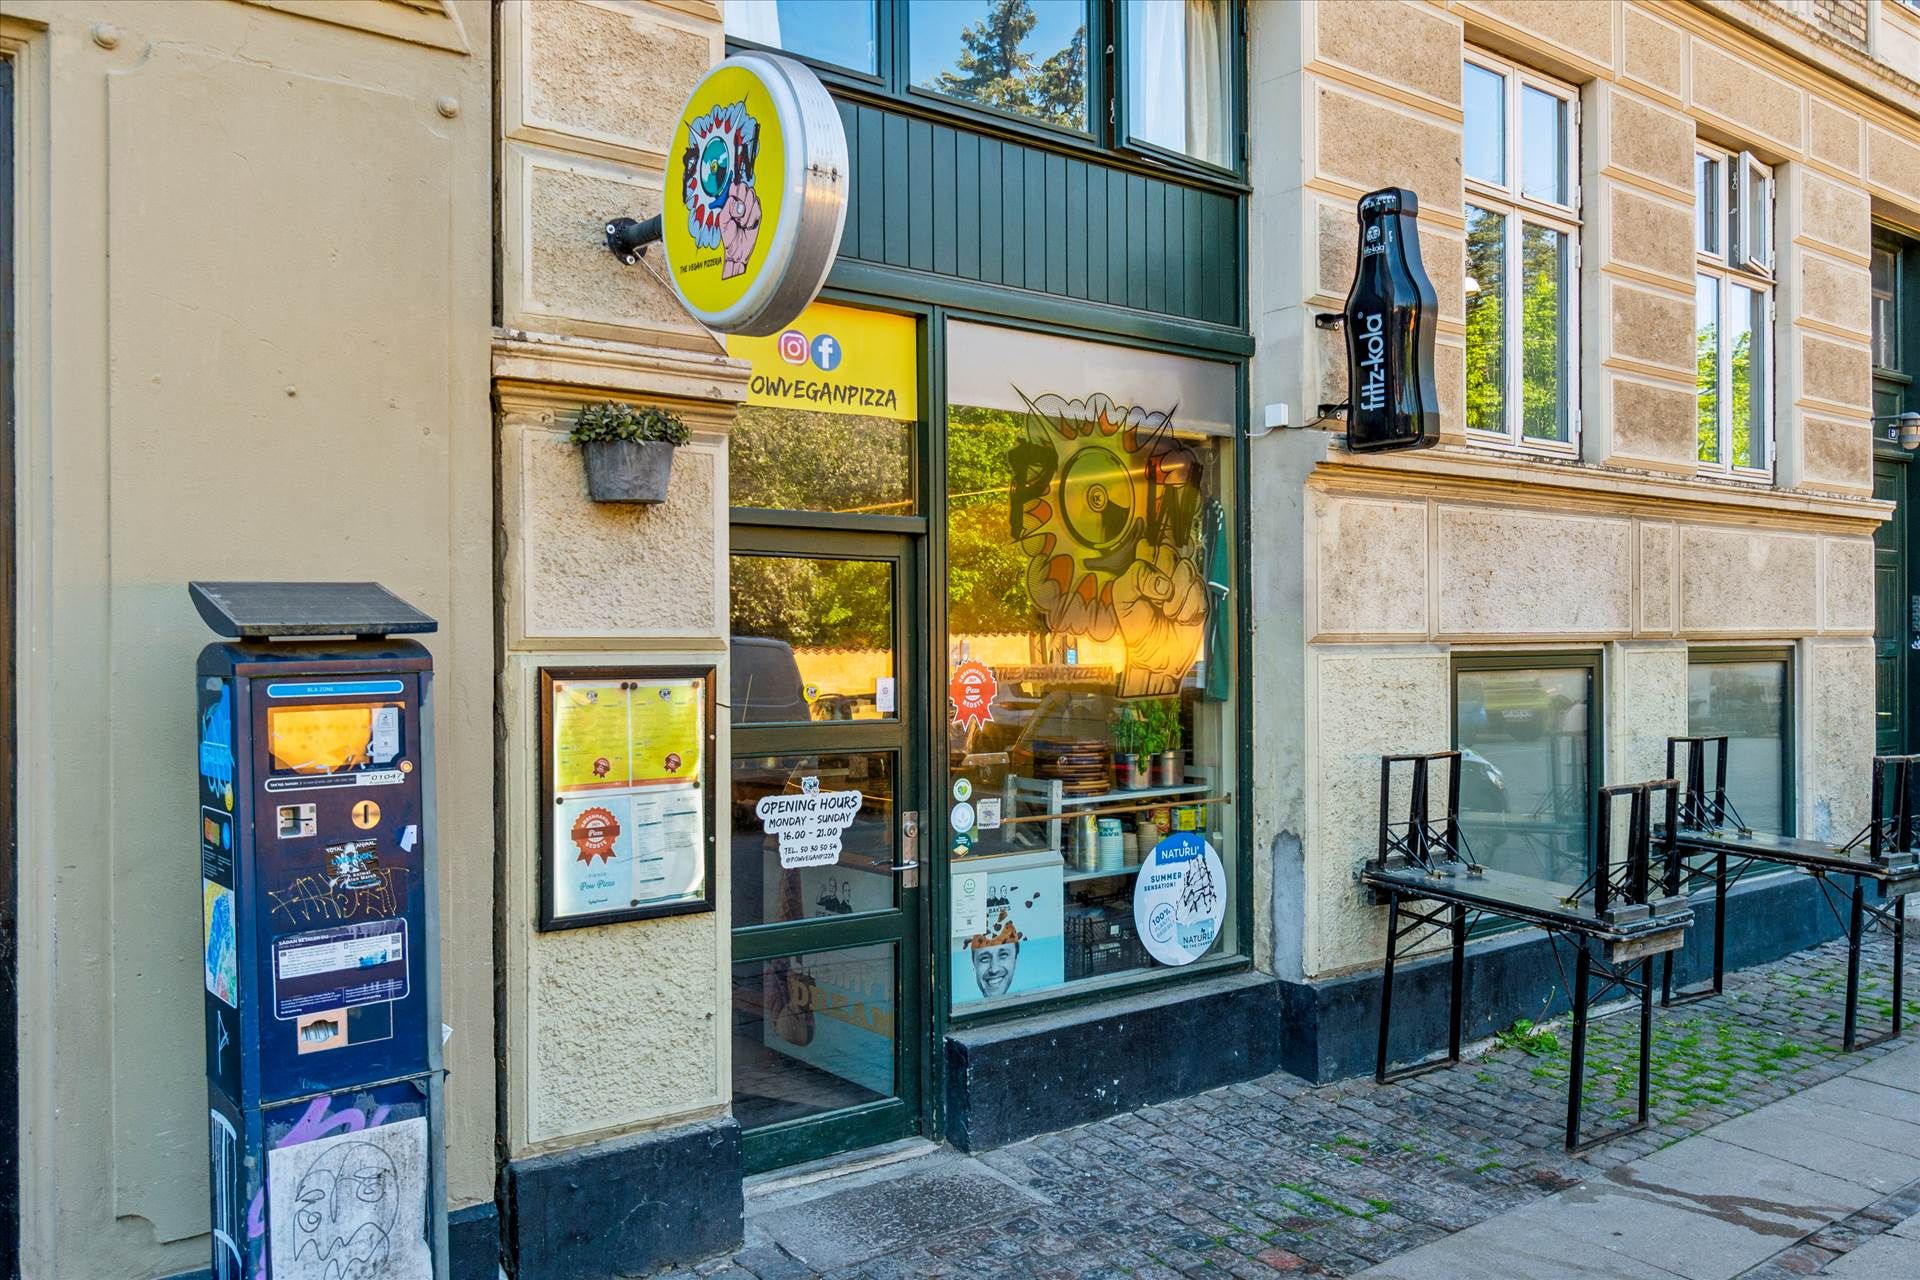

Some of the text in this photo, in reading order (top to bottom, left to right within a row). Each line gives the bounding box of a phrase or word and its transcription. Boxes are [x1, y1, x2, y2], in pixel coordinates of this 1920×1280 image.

[1360, 313, 1385, 412] fritz-kola
[761, 795, 858, 815] OPENING HOURS
[768, 816, 807, 828] MONDAY
[817, 812, 852, 824] SUNDAY
[783, 830, 806, 840] 16.00
[816, 827, 838, 838] 21.00
[1150, 872, 1182, 883] SUMMER
[1144, 882, 1176, 892] SENSATION!
